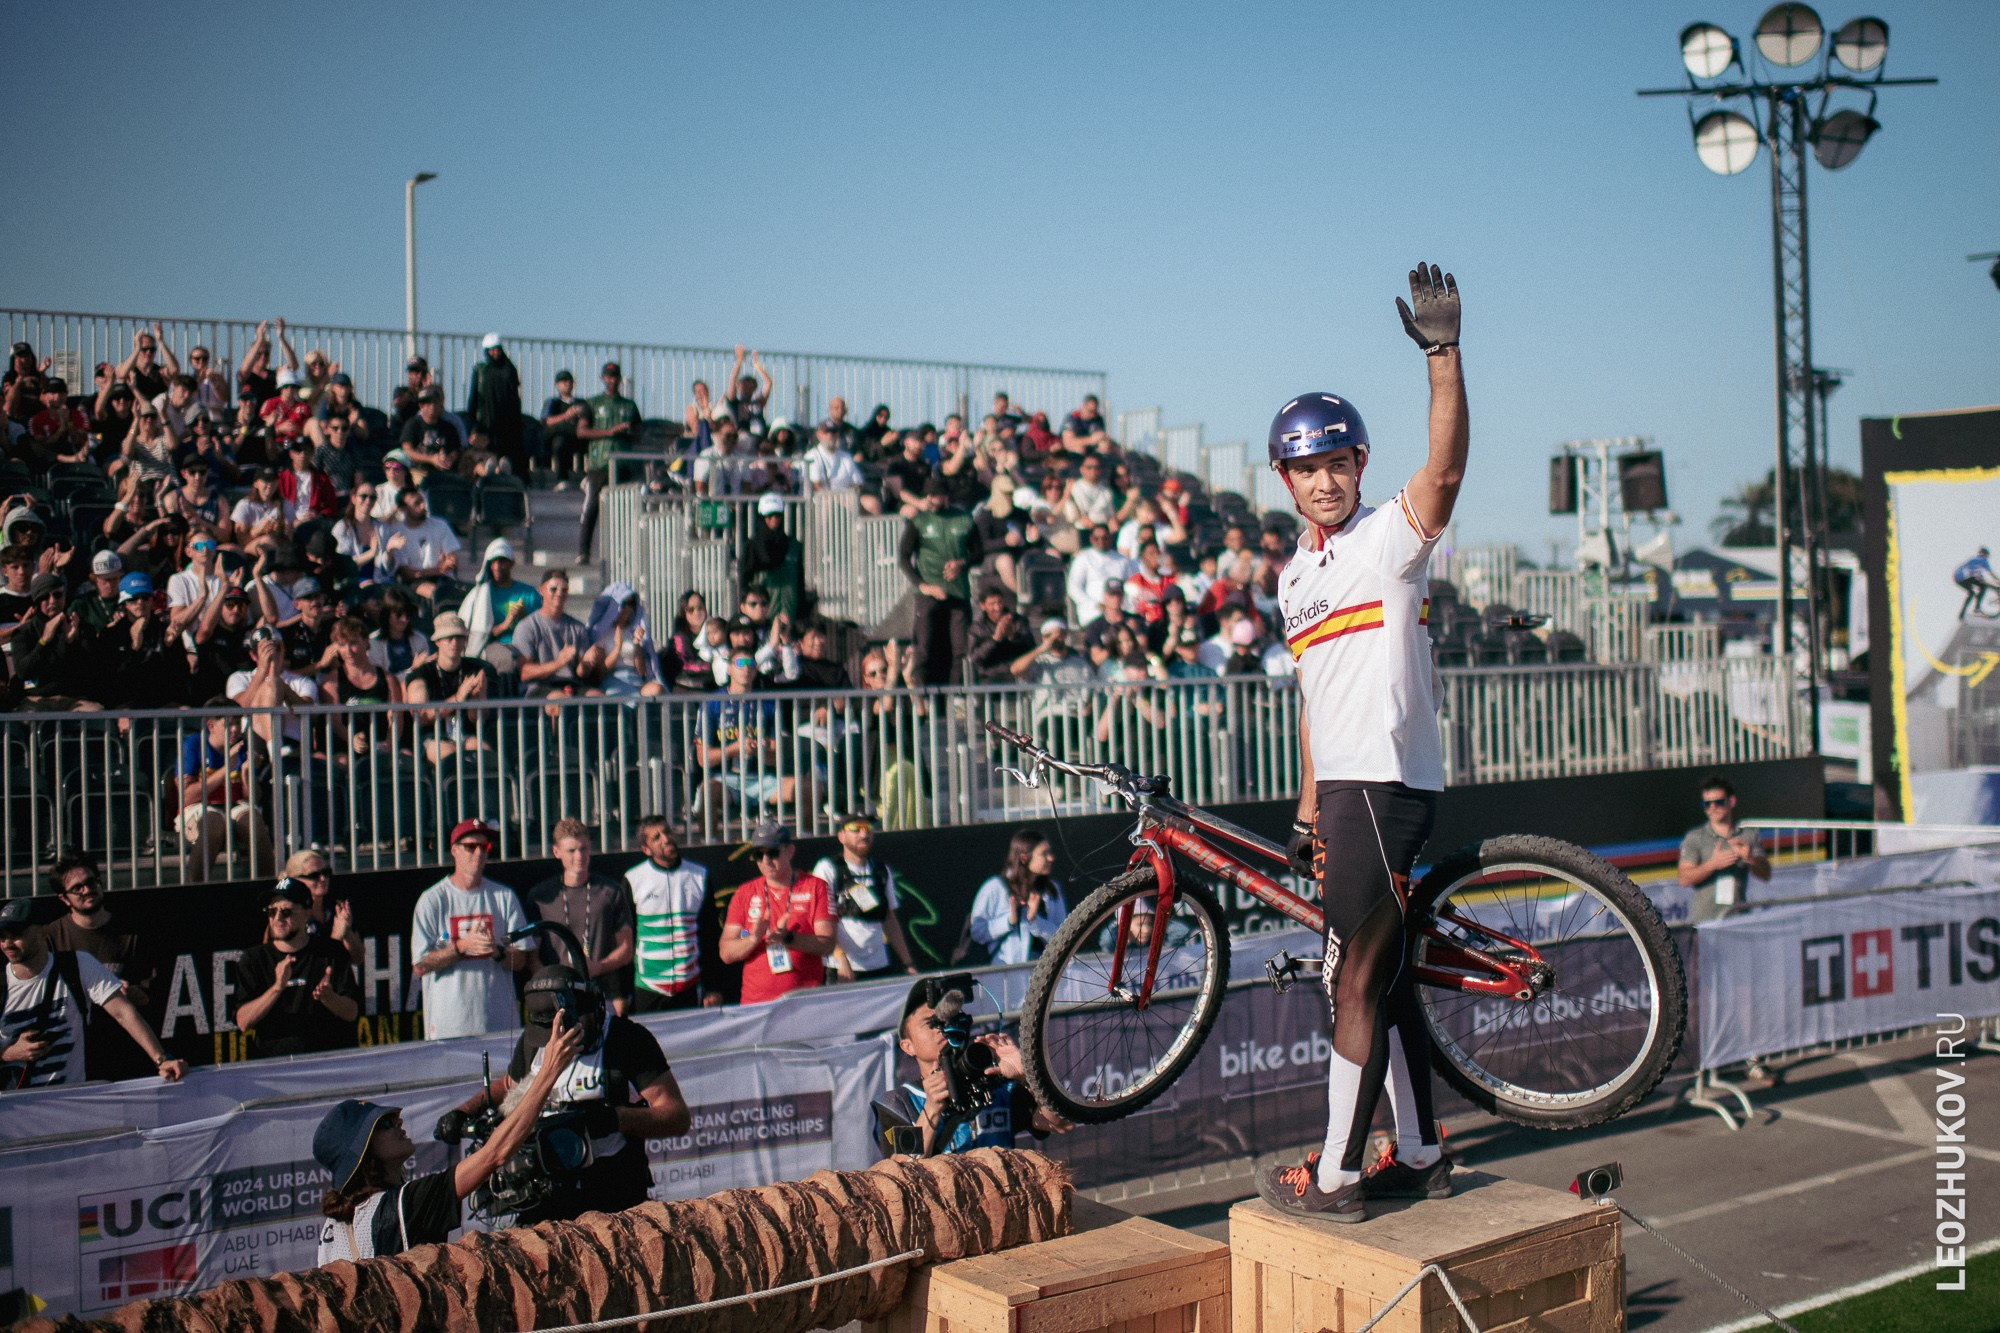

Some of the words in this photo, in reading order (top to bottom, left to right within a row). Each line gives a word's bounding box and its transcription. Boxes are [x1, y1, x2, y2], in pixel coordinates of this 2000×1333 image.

[1220, 1039, 1287, 1079] bike
[730, 1103, 797, 1124] CYCLING
[645, 1136, 693, 1154] ORLD
[695, 1118, 825, 1148] CHAMPIONSHIPS
[221, 1179, 265, 1198] 2024
[269, 1168, 334, 1191] URBAN
[103, 1187, 203, 1239] UCI
[221, 1195, 293, 1219] WORLD
[223, 1232, 261, 1256] ABU
[224, 1254, 261, 1275] UAE
